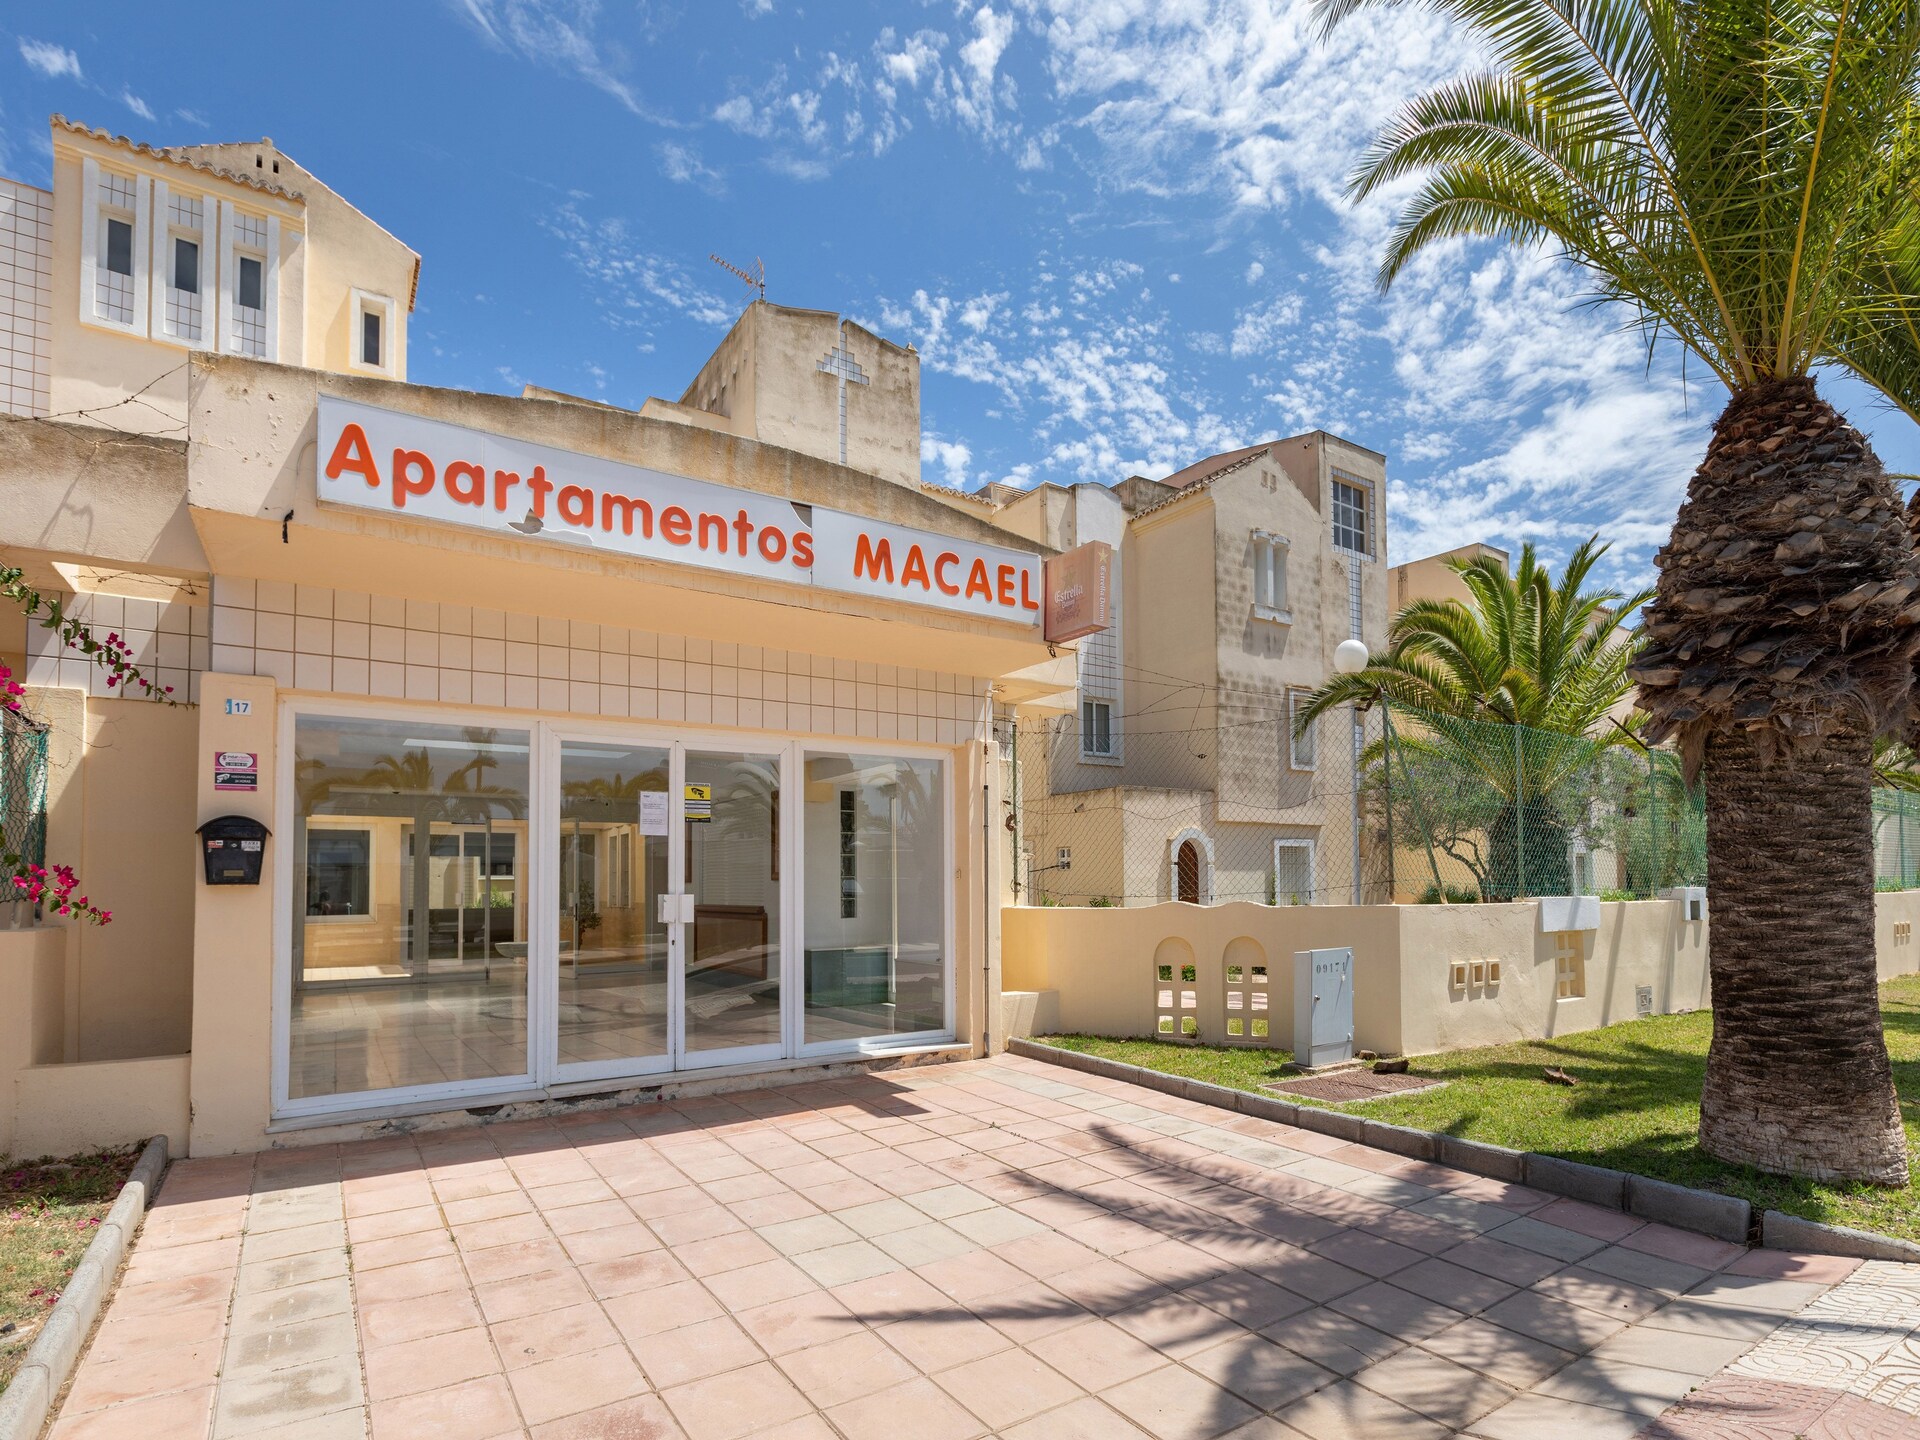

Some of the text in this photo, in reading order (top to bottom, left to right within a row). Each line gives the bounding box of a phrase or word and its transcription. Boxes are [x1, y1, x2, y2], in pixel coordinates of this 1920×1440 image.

[325, 422, 1040, 611] Apartamentos MACAEL
[234, 702, 249, 713] 17
